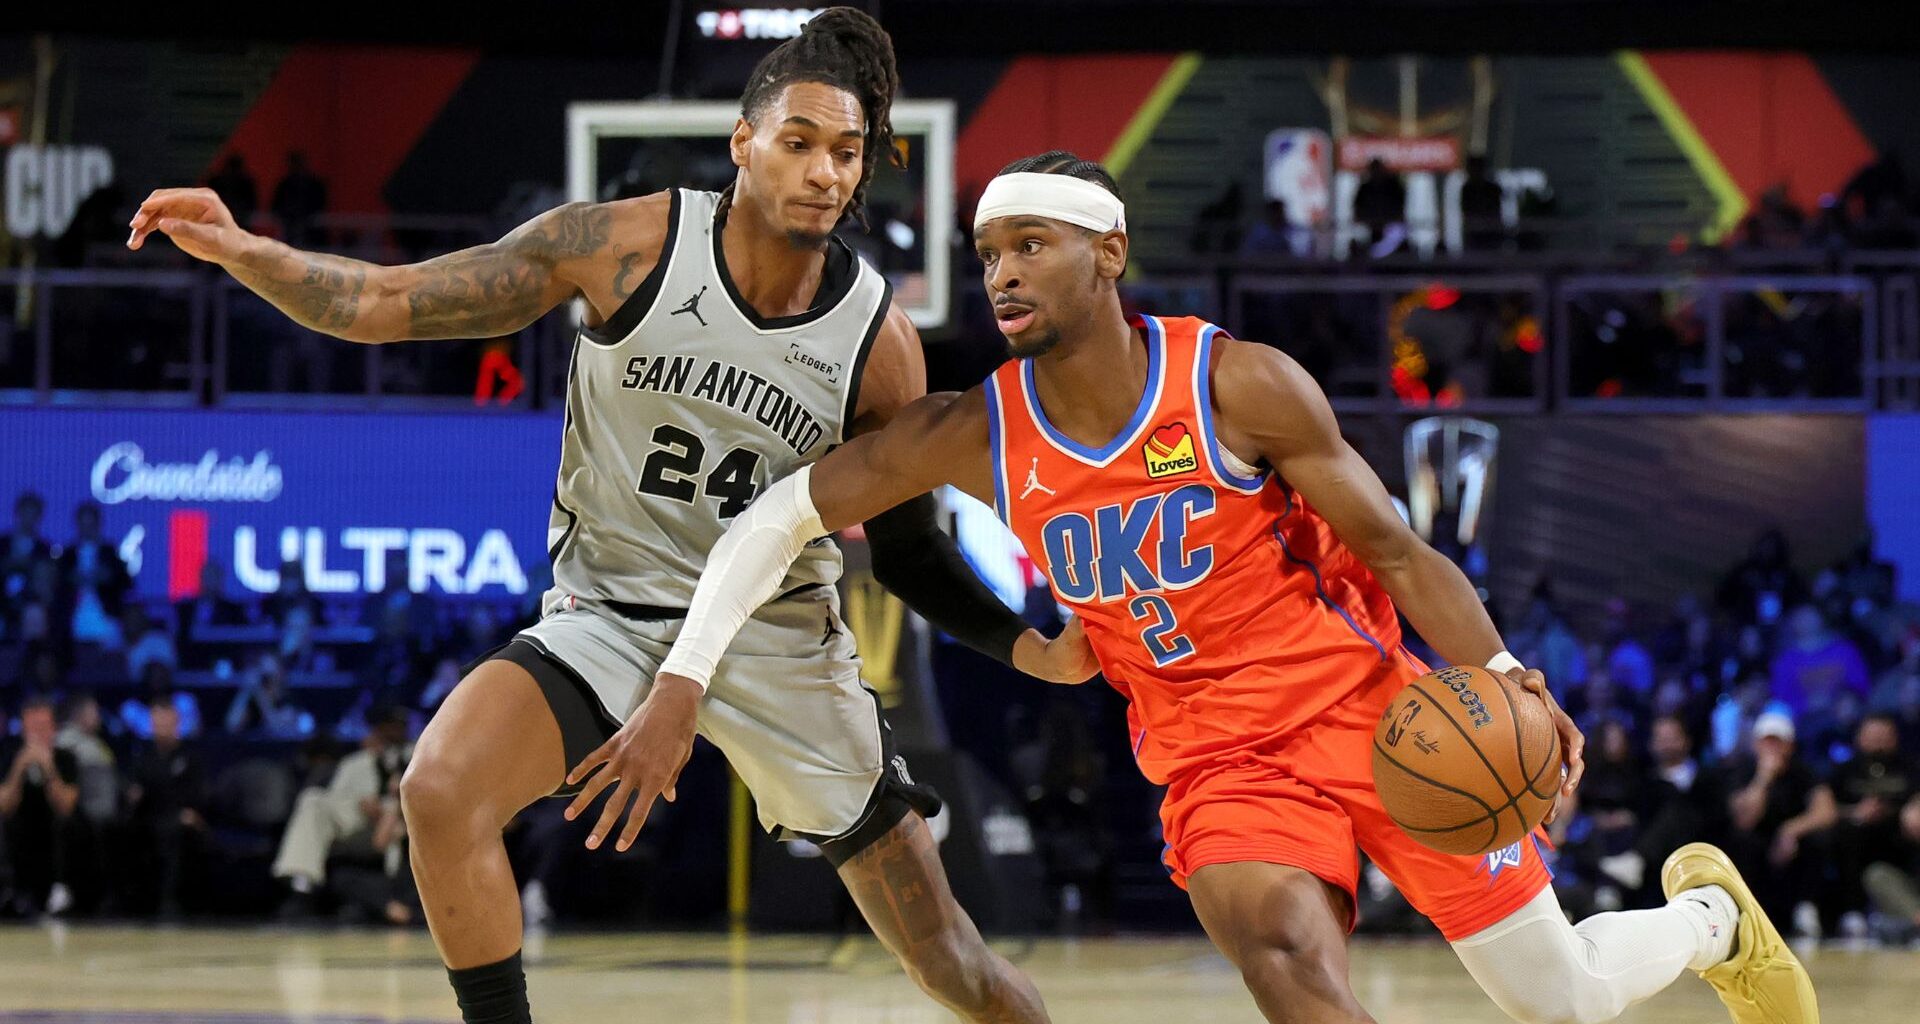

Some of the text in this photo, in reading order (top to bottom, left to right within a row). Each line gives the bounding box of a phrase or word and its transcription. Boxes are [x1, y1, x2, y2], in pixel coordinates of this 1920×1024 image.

[621, 354, 824, 457] SAN ANTONIO
[794, 351, 833, 376] LEDGER
[636, 423, 761, 521] 24
[234, 525, 529, 595] ULTRA
[1041, 483, 1216, 604] OKC
[1128, 594, 1196, 669] 2
